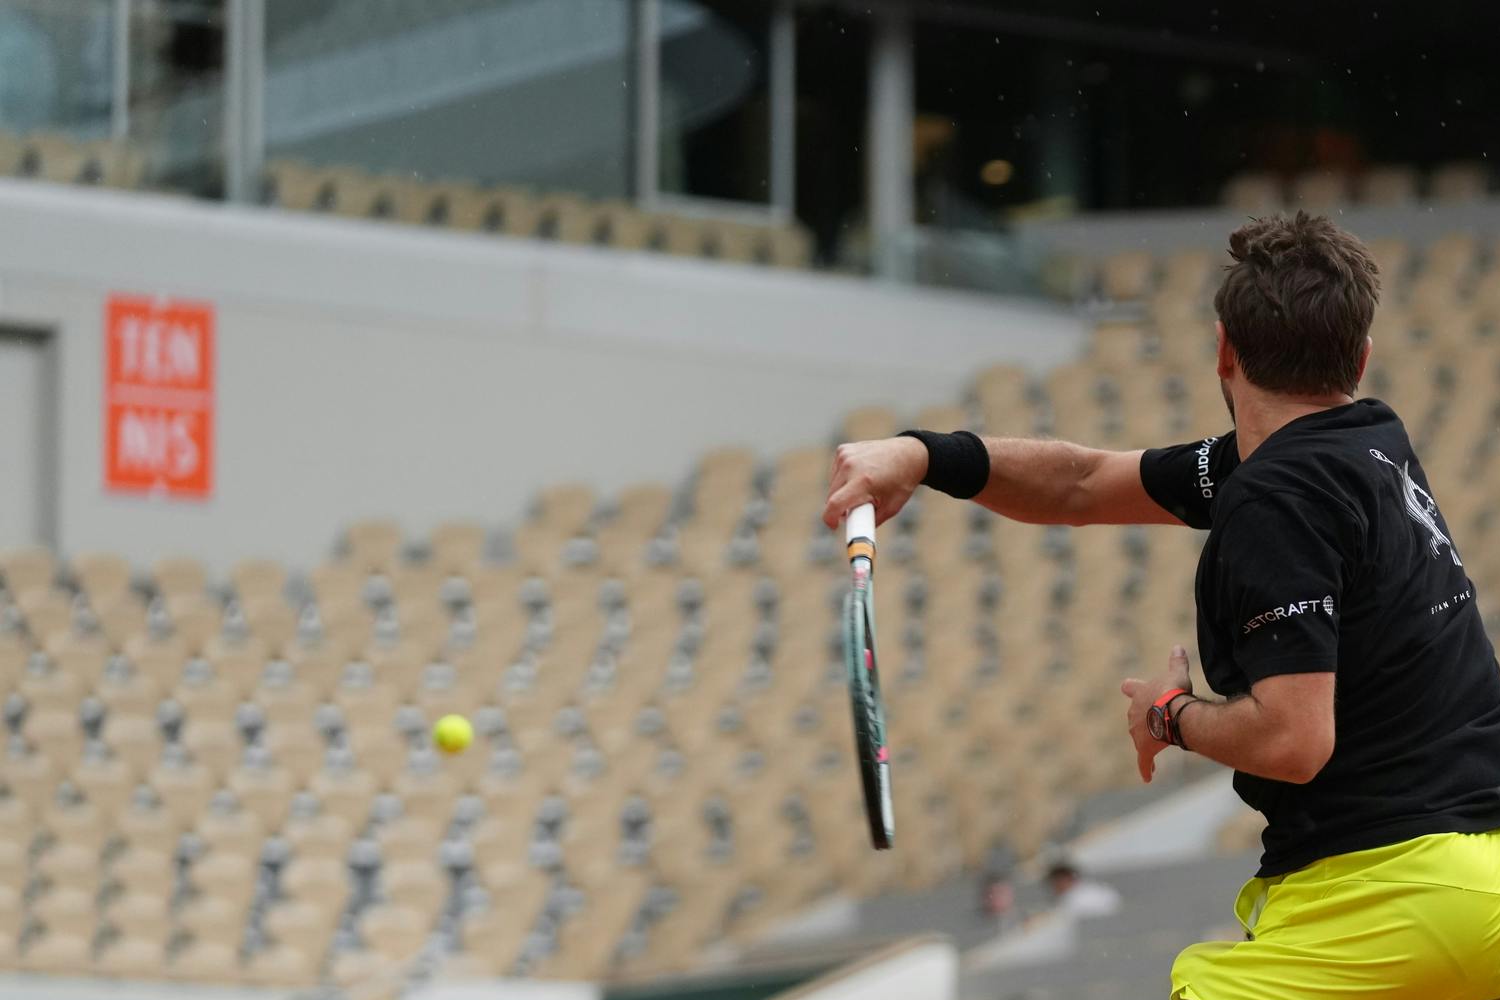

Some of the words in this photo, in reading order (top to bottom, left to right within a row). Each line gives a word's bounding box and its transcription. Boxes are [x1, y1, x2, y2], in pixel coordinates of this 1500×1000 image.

[121, 318, 200, 381] TEN
[117, 408, 199, 477] NIS
[1242, 600, 1320, 634] JETCRAFT
[1453, 590, 1471, 603] THE
